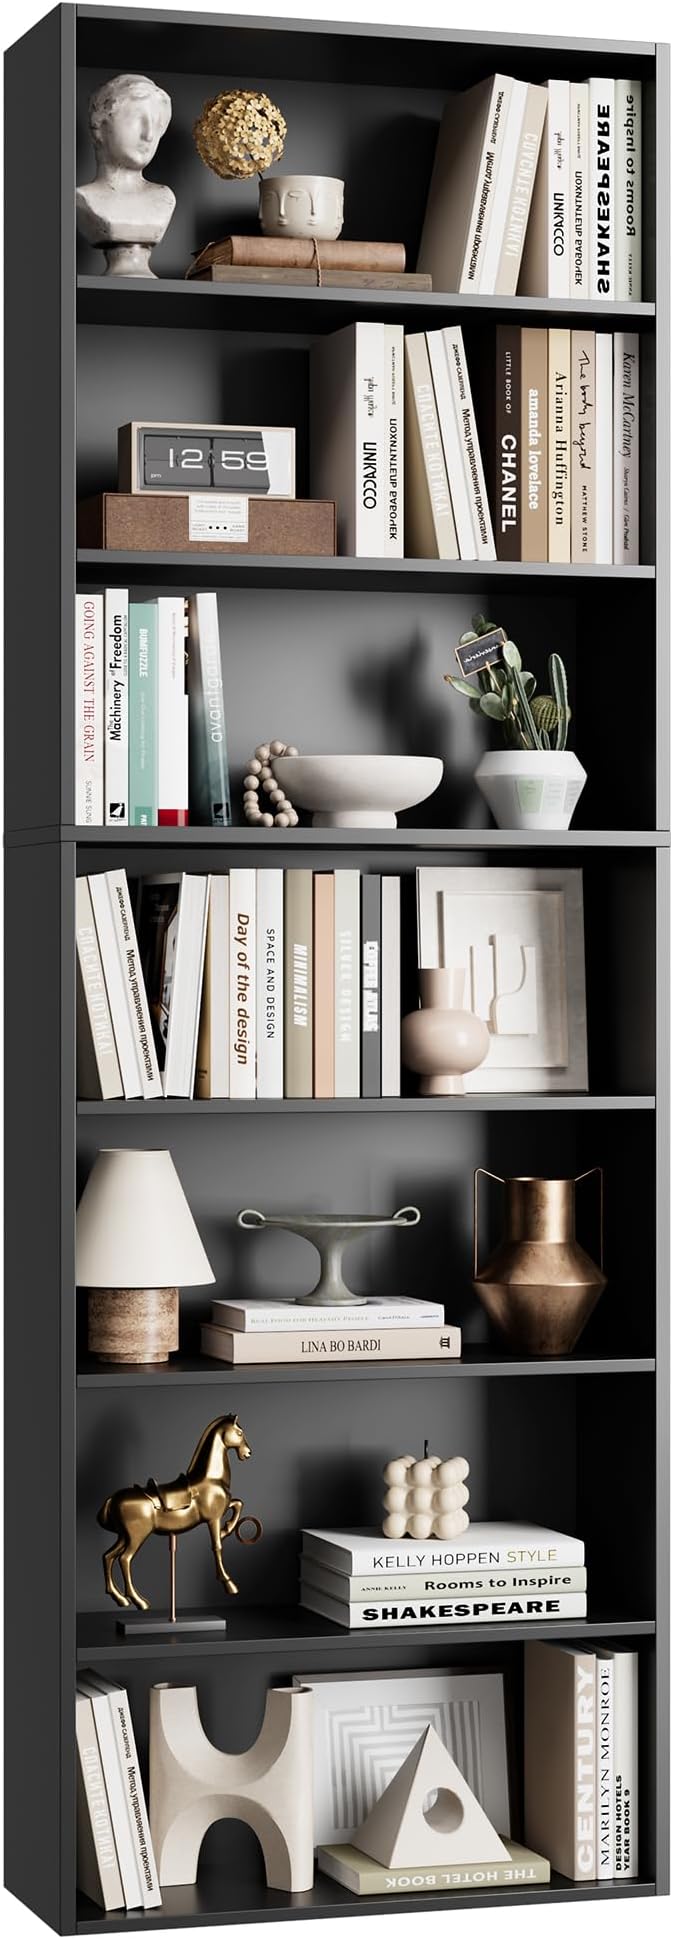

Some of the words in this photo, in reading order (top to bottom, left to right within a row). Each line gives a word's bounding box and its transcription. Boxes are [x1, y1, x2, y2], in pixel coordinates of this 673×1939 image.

[622, 352, 635, 388] Karen
[528, 388, 539, 446] amanda
[555, 372, 568, 433] Arianna
[619, 392, 635, 458] McCartney
[169, 448, 204, 469] 12
[221, 450, 269, 471] 59
[501, 434, 517, 533] CHANEL
[528, 449, 540, 510] lovelace
[552, 440, 568, 525] Huffington
[84, 601, 95, 640] GOING
[109, 614, 122, 669] Freedom
[139, 628, 148, 678] BUMFUZZLE
[84, 643, 95, 694] AGAINST
[109, 669, 116, 677] of
[84, 698, 95, 721] THE
[110, 680, 125, 741] Machinery
[84, 725, 95, 762] GRAIN
[234, 913, 250, 946] Day
[266, 928, 275, 964] SPACE
[237, 951, 250, 970] of
[237, 973, 250, 1002] the
[266, 968, 275, 992] AND
[293, 943, 308, 1026] MINIMALISM
[234, 1008, 250, 1065] design
[266, 997, 275, 1039] DESIGN
[301, 1340, 327, 1353] LINA
[329, 1340, 346, 1352] BO
[347, 1339, 381, 1352] BARDI
[373, 1555, 426, 1568] KELLY
[431, 1552, 500, 1566] HOPPEN
[507, 1549, 557, 1563] STYLE
[425, 1579, 483, 1591] Rooms
[489, 1578, 507, 1588] to
[513, 1576, 572, 1588] Inspire
[362, 1600, 560, 1621] SHAKESPEARE
[601, 1667, 610, 1760] MONROE
[577, 1664, 594, 1873] CENTURY
[624, 1789, 630, 1797] 9
[601, 1769, 610, 1865] MARILYN
[385, 1875, 436, 1888] BOOK
[442, 1871, 498, 1884] HOTEL
[504, 1868, 537, 1880] THE
